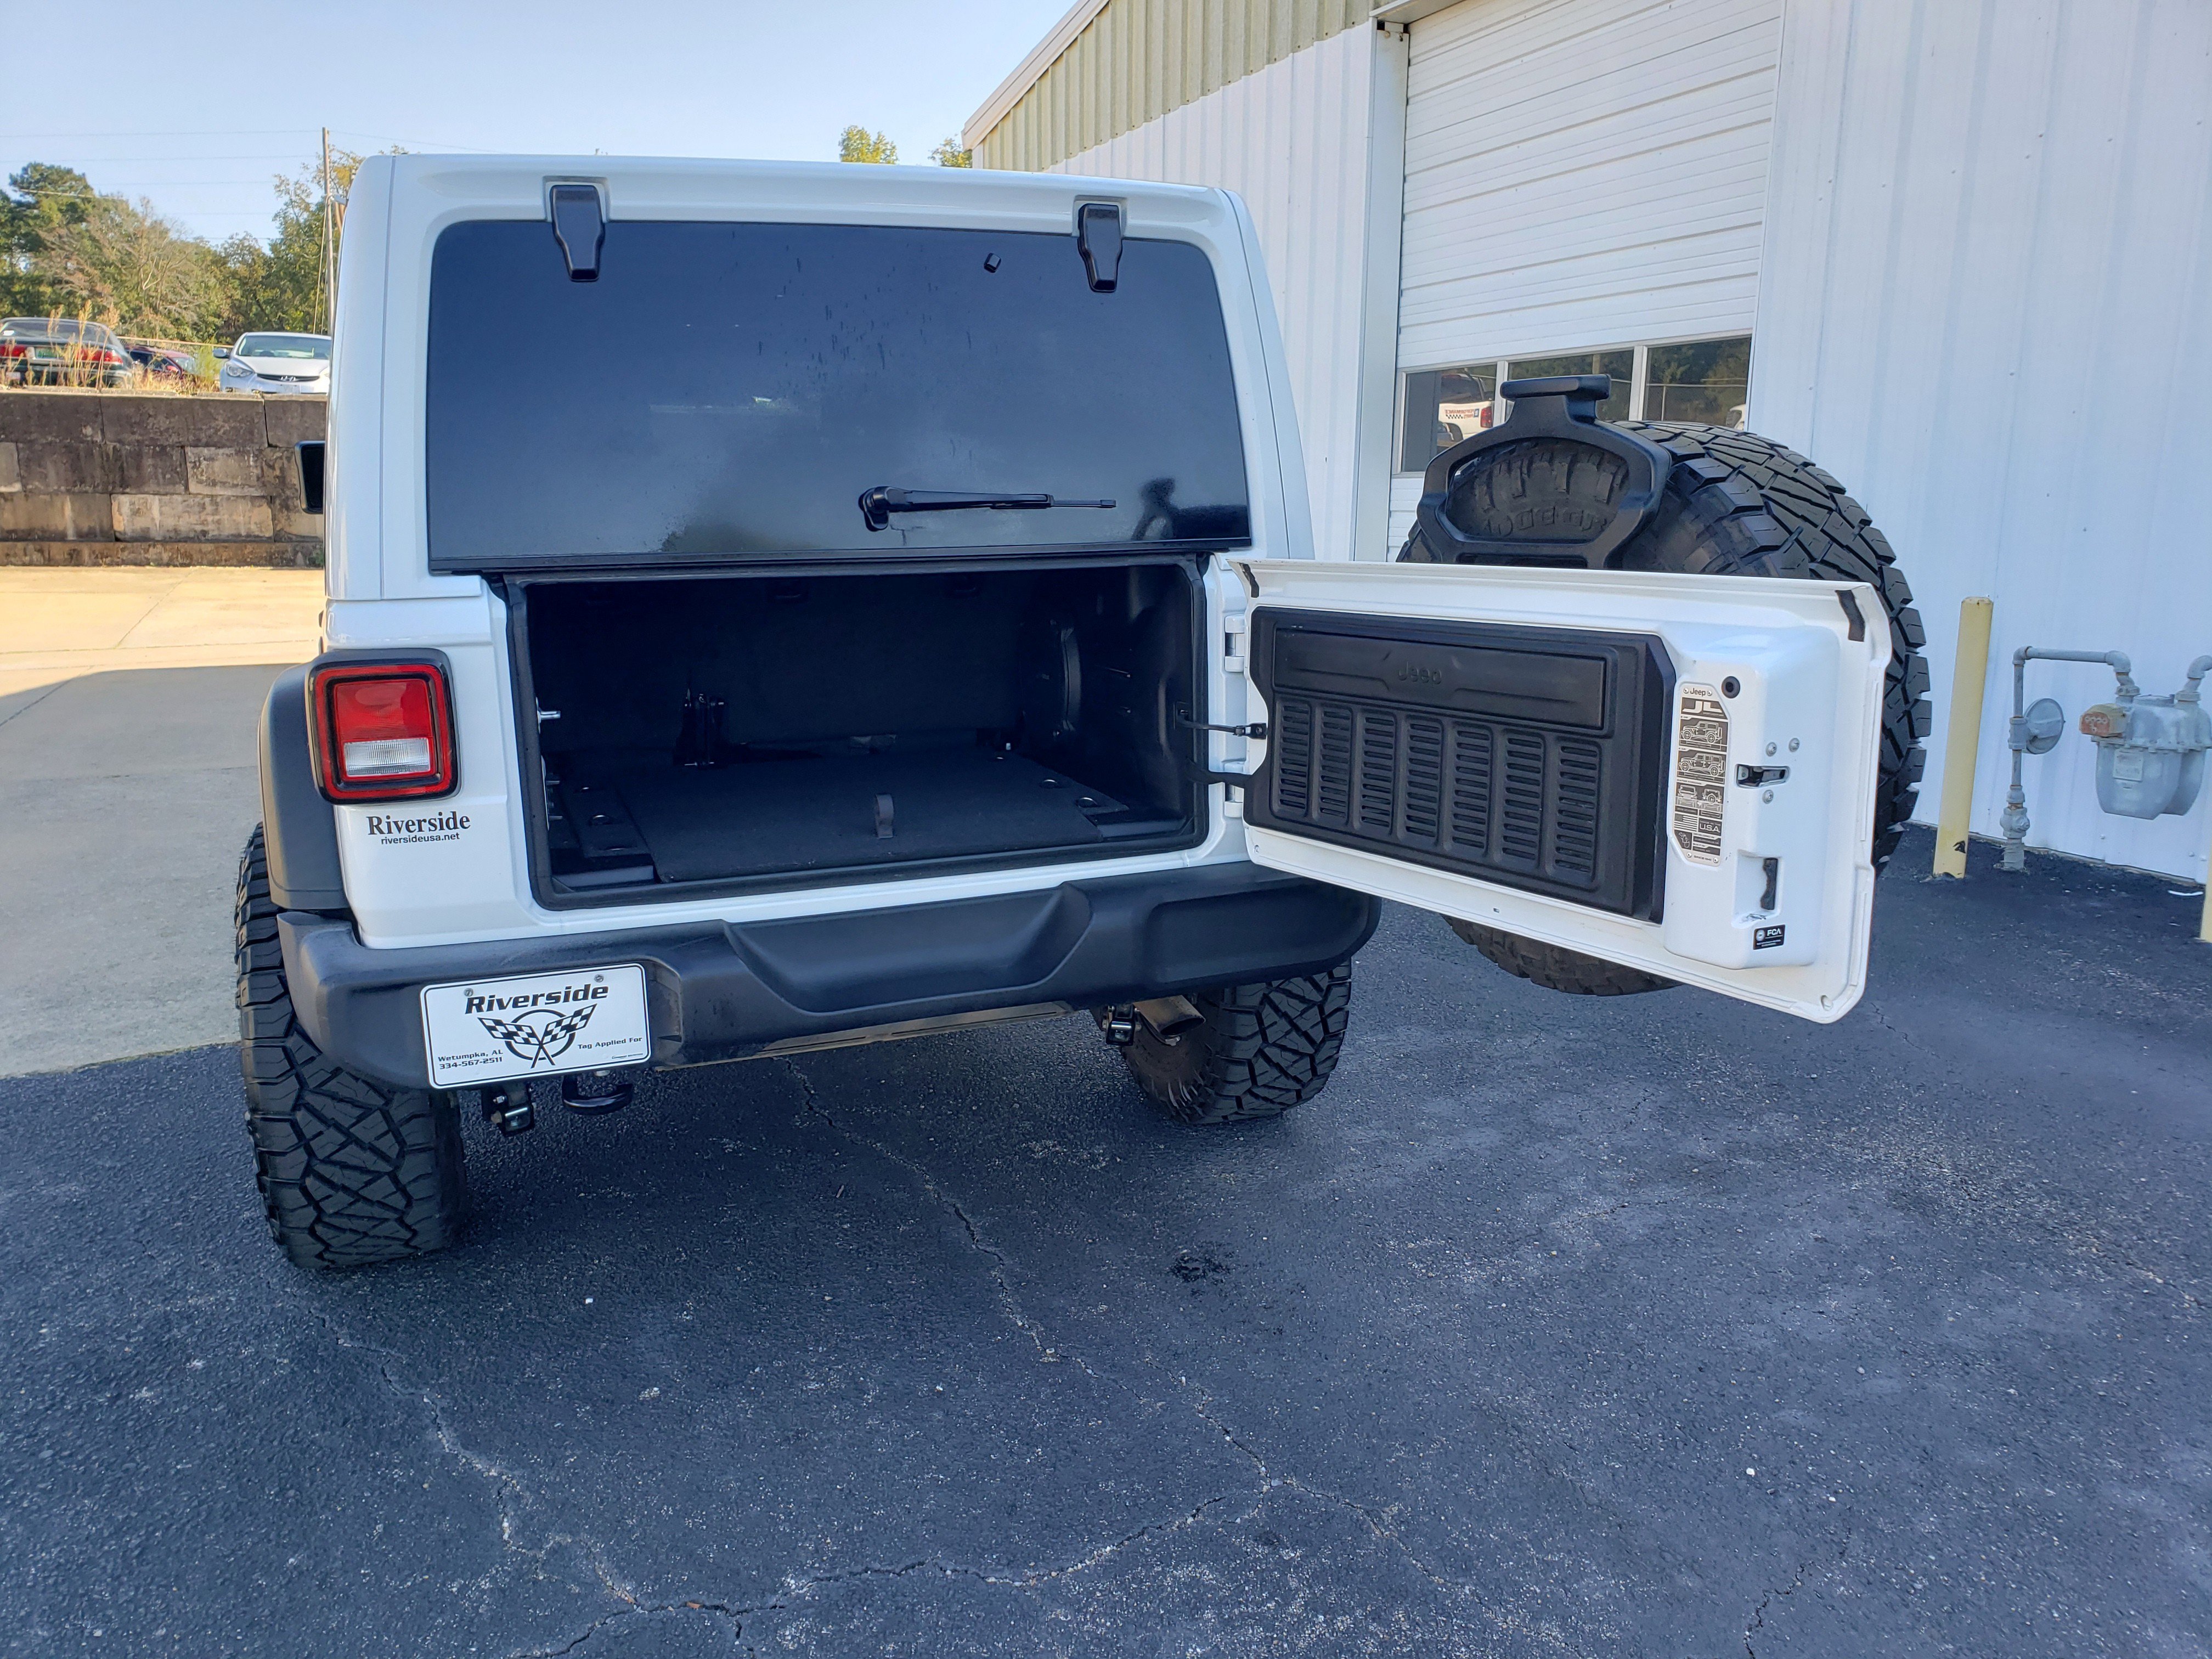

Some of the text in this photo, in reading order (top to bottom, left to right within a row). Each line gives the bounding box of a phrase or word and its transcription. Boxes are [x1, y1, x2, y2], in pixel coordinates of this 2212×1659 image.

[1398, 661, 1442, 688] Jeep
[1690, 687, 1706, 697] Jeep
[1681, 700, 1723, 713] JL
[366, 811, 471, 835] Riverside
[1699, 823, 1720, 833] U.S.A.
[381, 832, 460, 844] riversideusa.net
[1767, 928, 1782, 936] FCA
[465, 983, 609, 1014] Riverside
[595, 1038, 627, 1047] Applied
[438, 1051, 489, 1062] Wetumpka,
[439, 1056, 503, 1070] 334-567-2511
